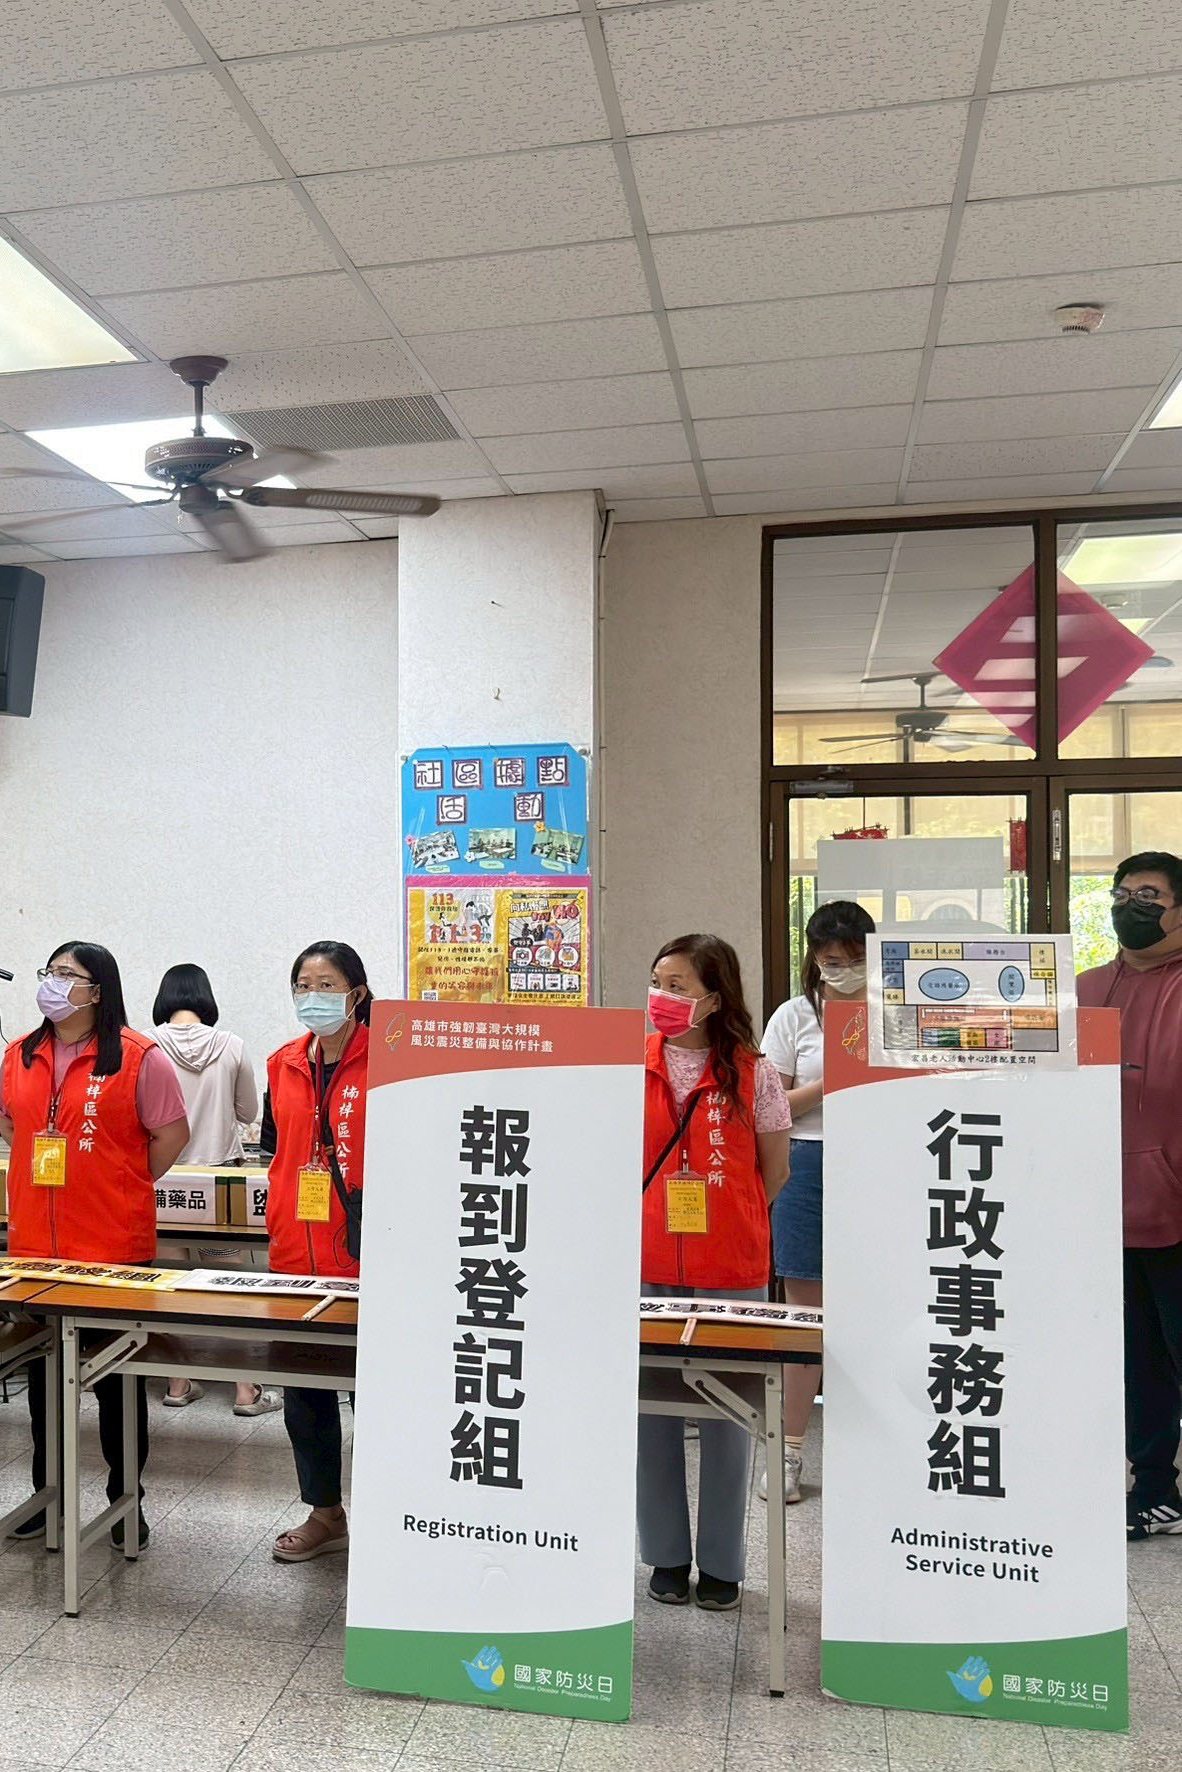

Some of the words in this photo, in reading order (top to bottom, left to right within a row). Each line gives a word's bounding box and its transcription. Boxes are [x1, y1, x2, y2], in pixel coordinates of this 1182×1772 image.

[432, 892, 455, 906] 113
[411, 1019, 542, 1037] 高雄市強韌臺灣大規模
[410, 1034, 554, 1053] 風災震災整備與協作計畫
[449, 1104, 532, 1491] 報到登記組
[926, 1108, 1006, 1499] 行政事務組
[403, 1514, 528, 1546] Registration
[534, 1531, 579, 1552] Unit
[890, 1526, 1054, 1558] Administrative
[906, 1554, 985, 1578] Service
[993, 1562, 1040, 1583] Unit
[514, 1664, 613, 1694] 國家防災日
[1003, 1674, 1109, 1702] 國家防災日
